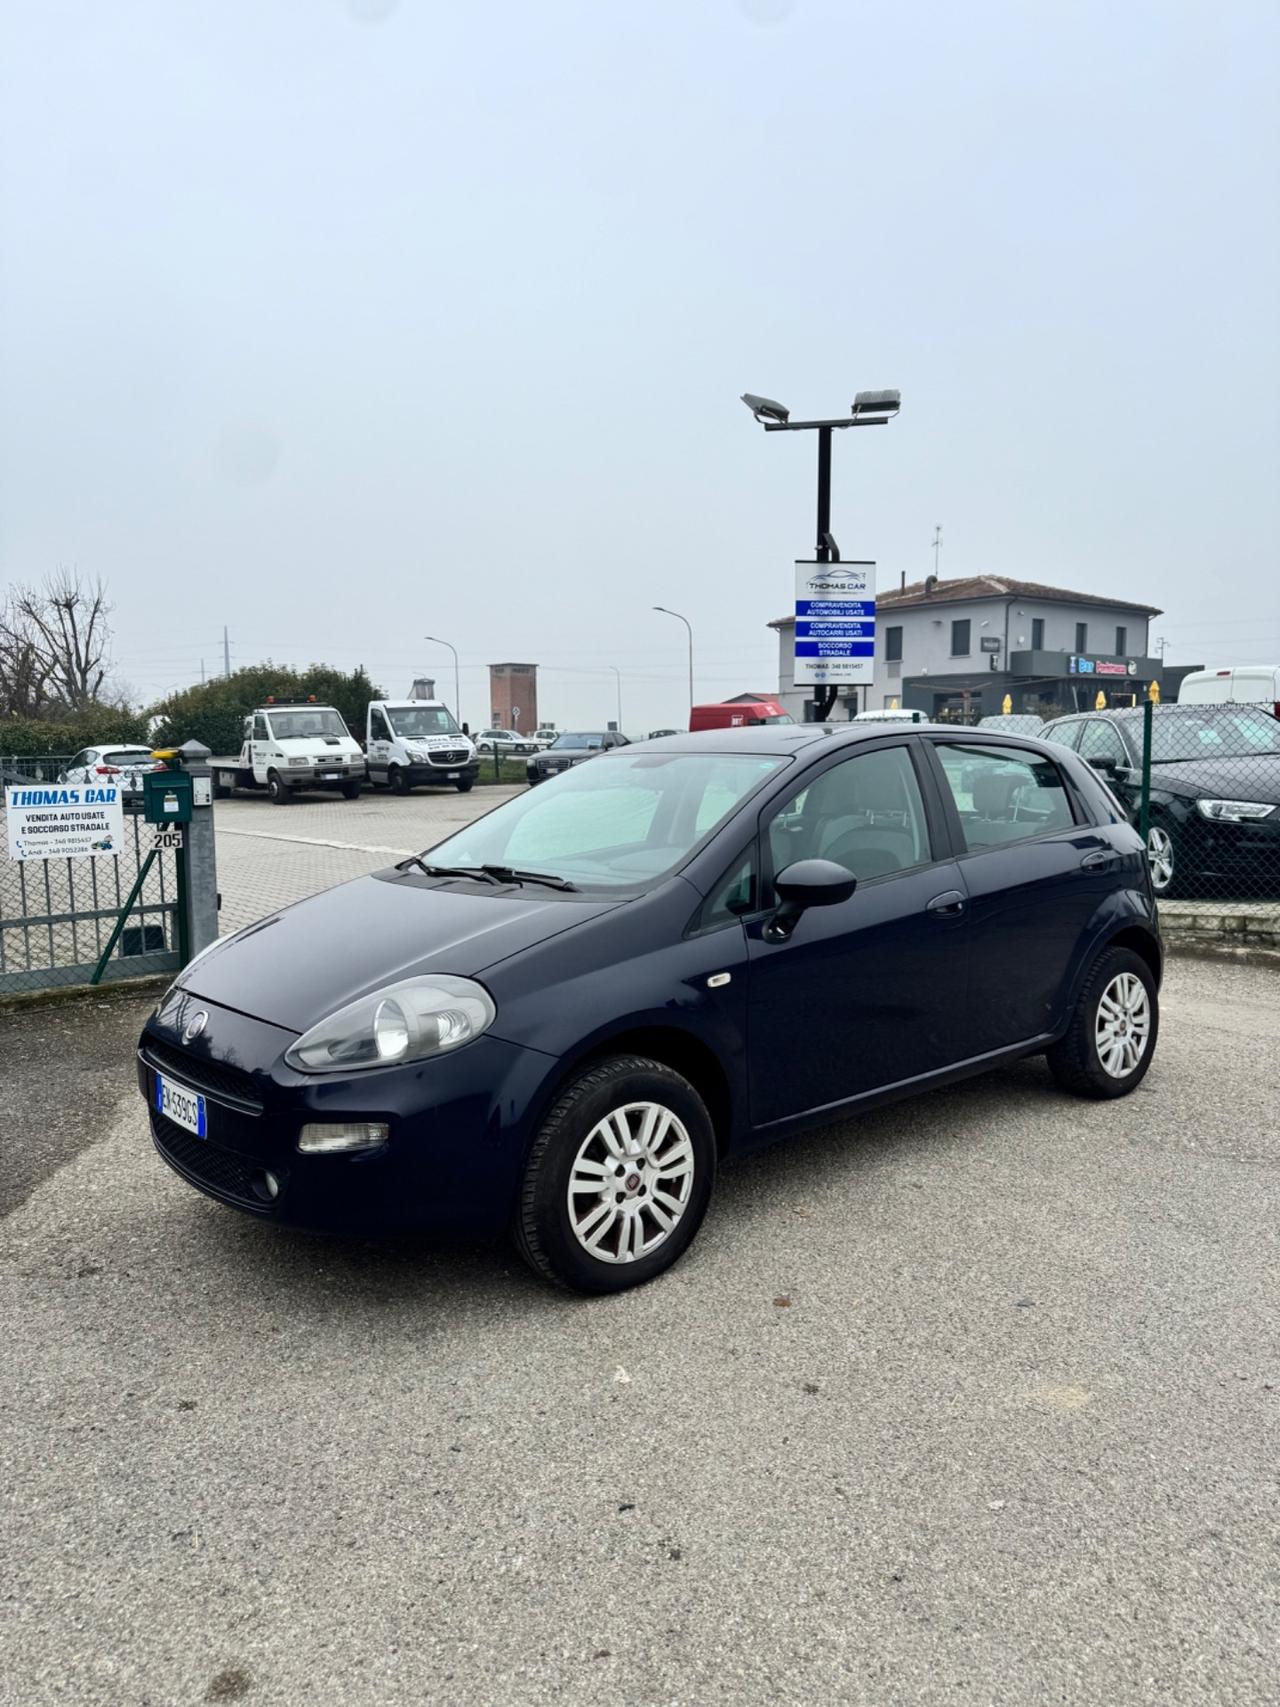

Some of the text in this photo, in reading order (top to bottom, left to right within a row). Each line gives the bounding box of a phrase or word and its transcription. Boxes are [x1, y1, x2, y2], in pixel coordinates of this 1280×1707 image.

[11, 788, 117, 806] THOMAS CAR
[25, 811, 105, 822] VENDITA AUTO USATE
[21, 822, 110, 834] E SOCCORSO STRADALE
[153, 833, 181, 848] 205
